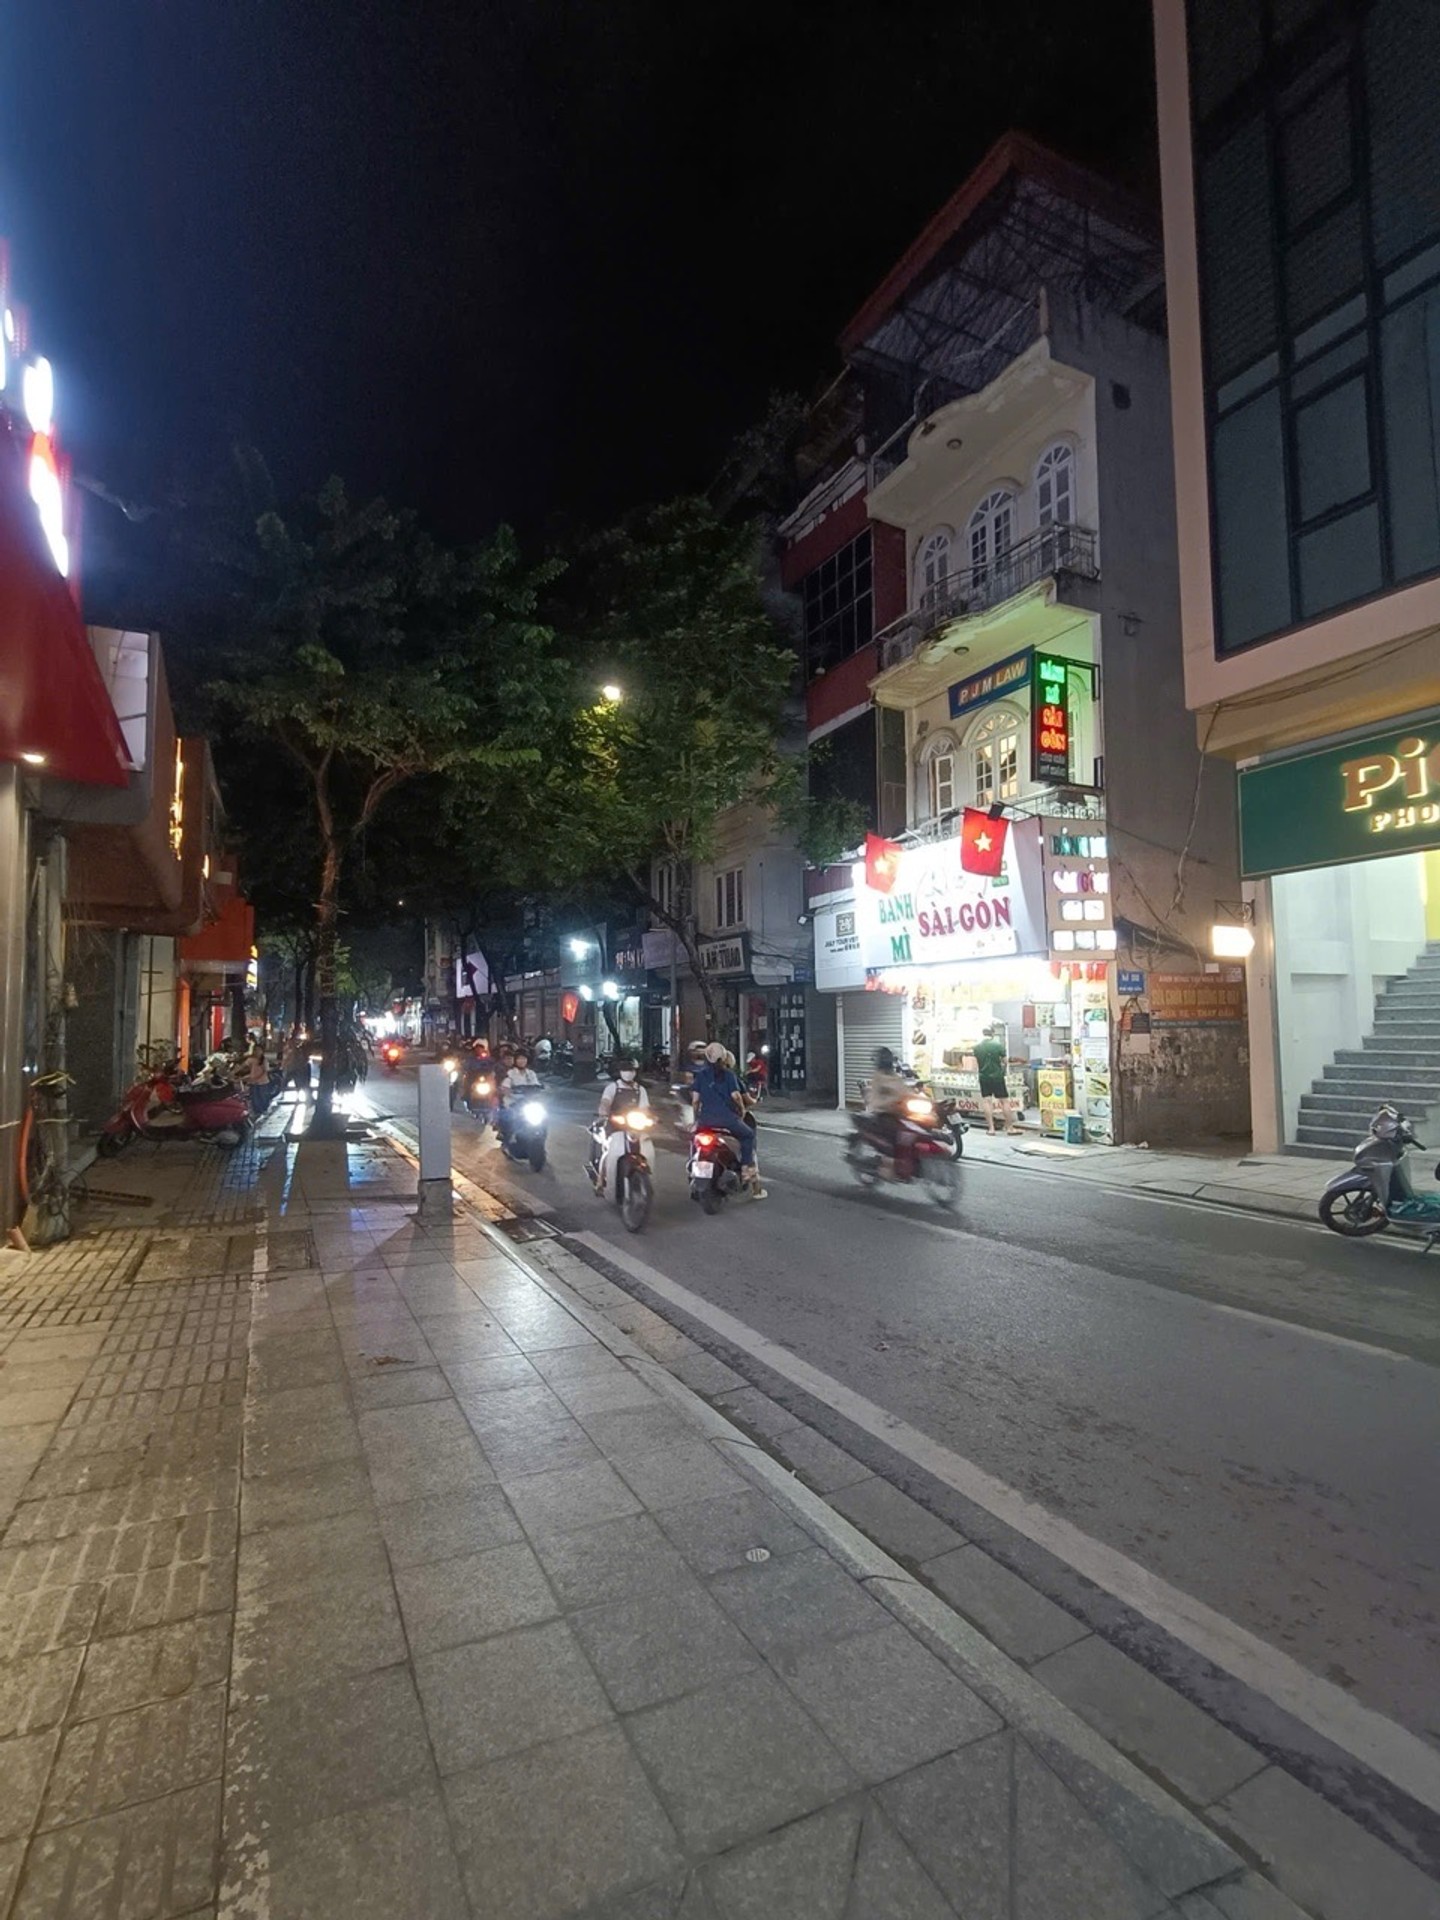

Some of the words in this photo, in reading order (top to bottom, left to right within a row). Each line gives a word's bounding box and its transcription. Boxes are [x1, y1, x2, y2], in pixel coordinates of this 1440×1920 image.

[996, 658, 1028, 691] LAW
[918, 901, 955, 938] SÀI
[958, 892, 1011, 932] GÒN
[890, 926, 912, 963] MÌ
